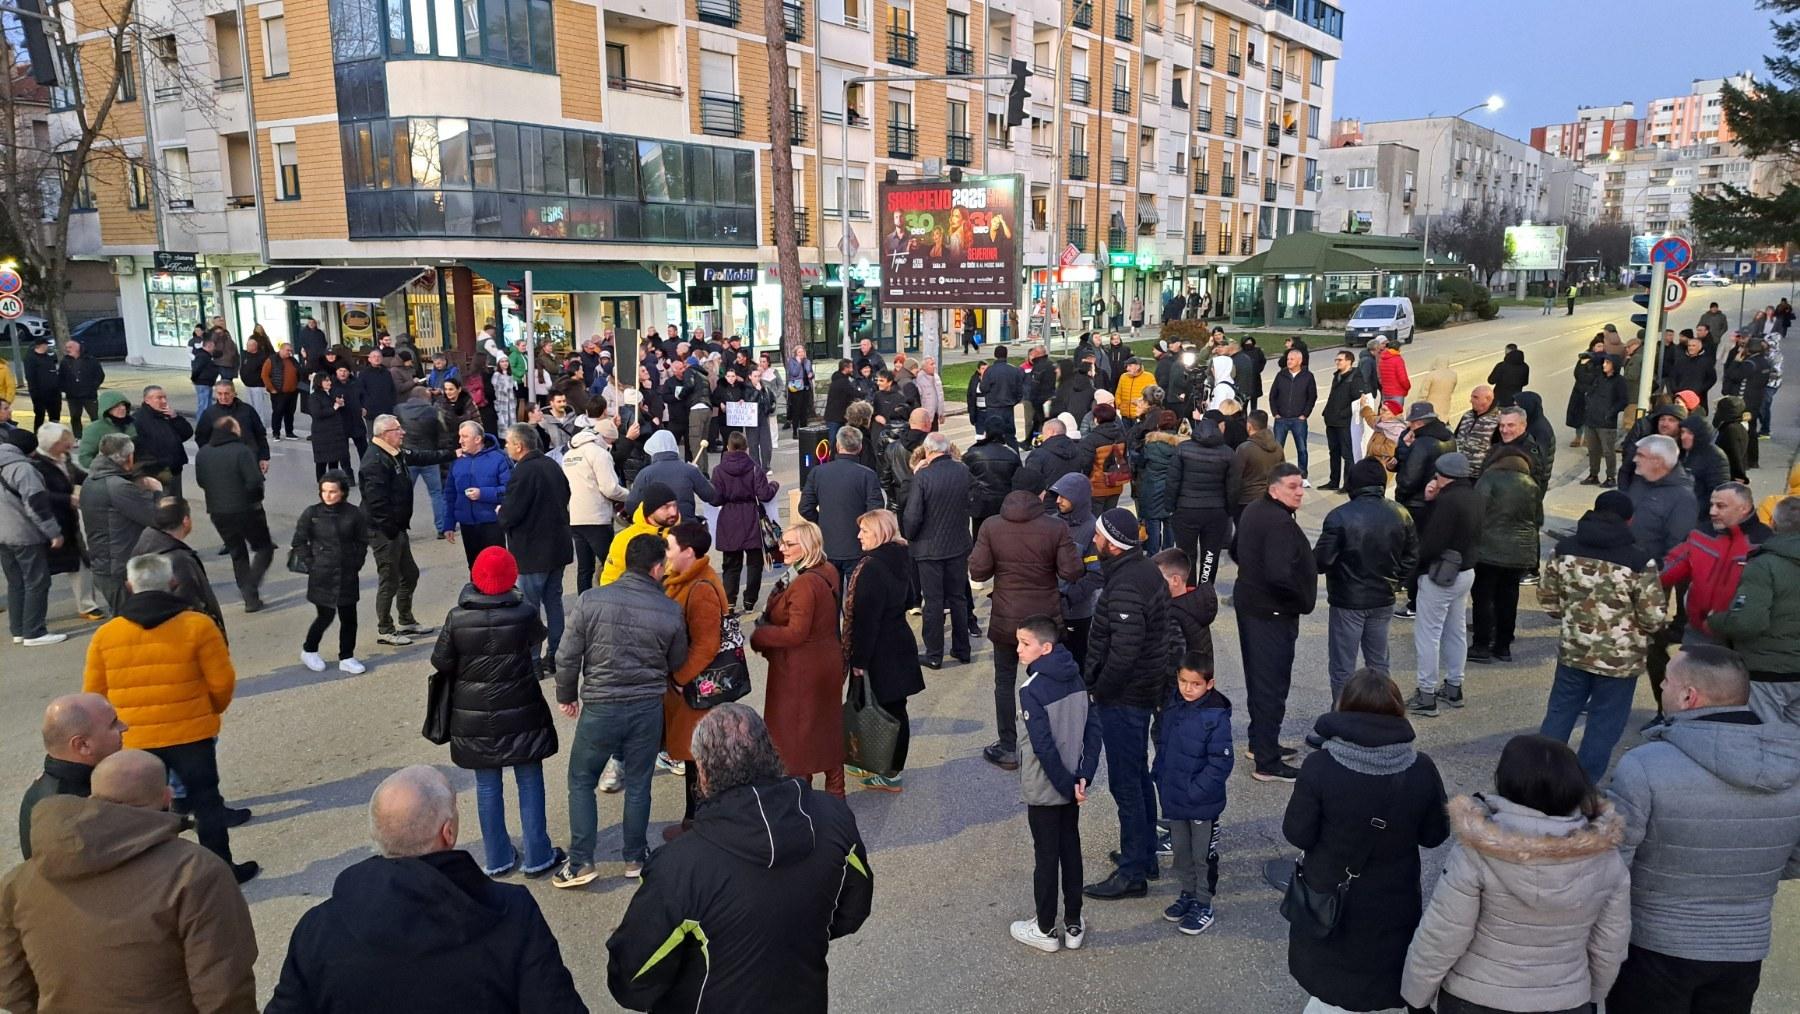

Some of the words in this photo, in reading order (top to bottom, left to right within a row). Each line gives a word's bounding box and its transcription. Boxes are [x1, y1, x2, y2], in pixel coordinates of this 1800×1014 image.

[888, 190, 951, 211] SARAJEVO
[905, 212, 934, 233] 30
[970, 211, 992, 229] 31
[967, 247, 998, 260] SEVERINA
[704, 268, 754, 281] ProMobil
[1739, 262, 1751, 276] P
[2, 301, 17, 312] 40
[1205, 550, 1214, 563] AIR
